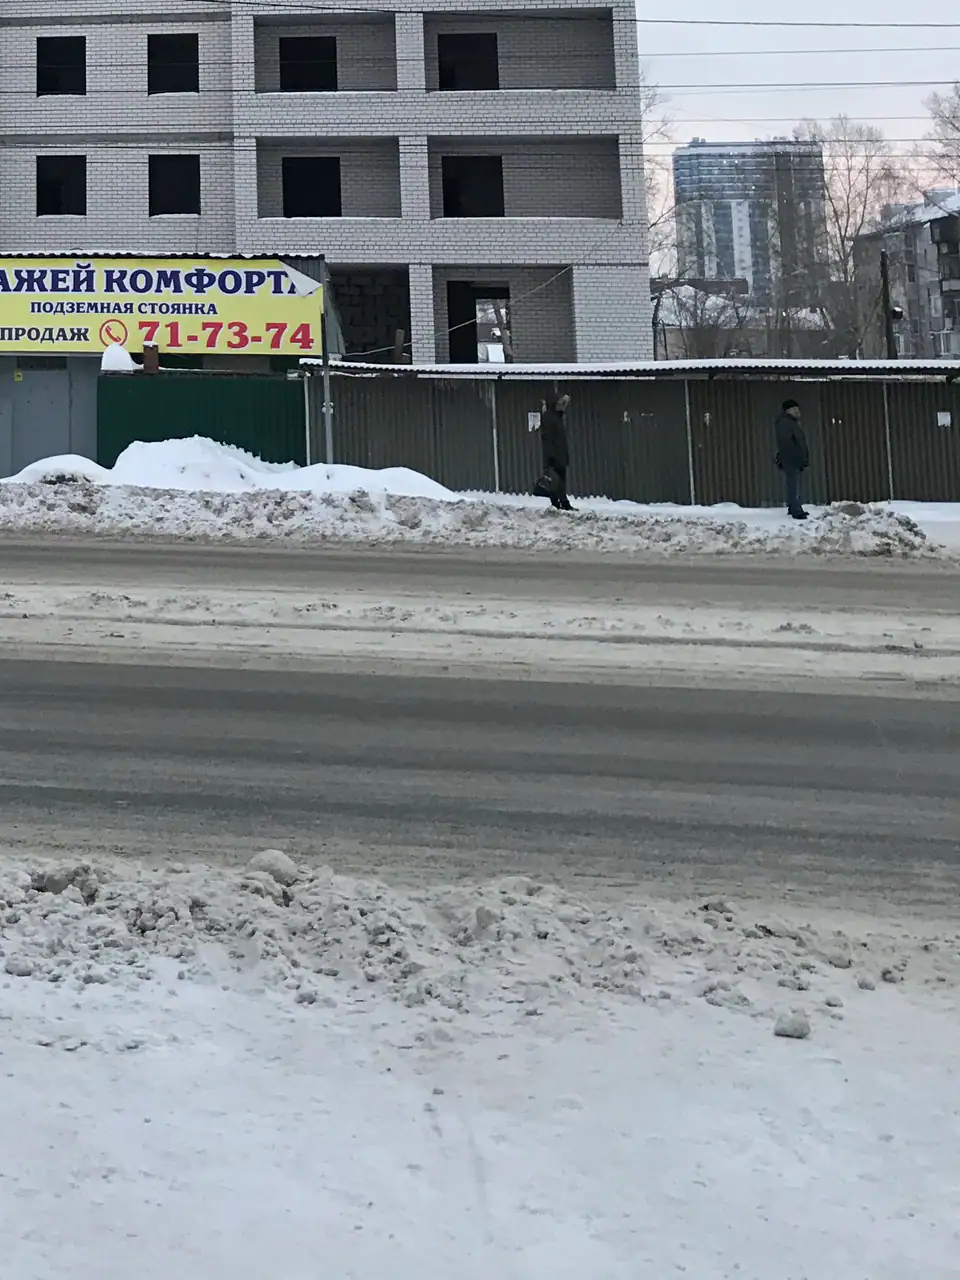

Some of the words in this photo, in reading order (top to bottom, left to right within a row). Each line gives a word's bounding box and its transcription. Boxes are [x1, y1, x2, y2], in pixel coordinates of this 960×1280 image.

[30, 301, 134, 315] ПОДЗЕМНАЯ
[137, 302, 218, 315] СТОЯНКА
[0, 327, 90, 343] ПРОДАЖ
[138, 320, 315, 350] 71-73-74
